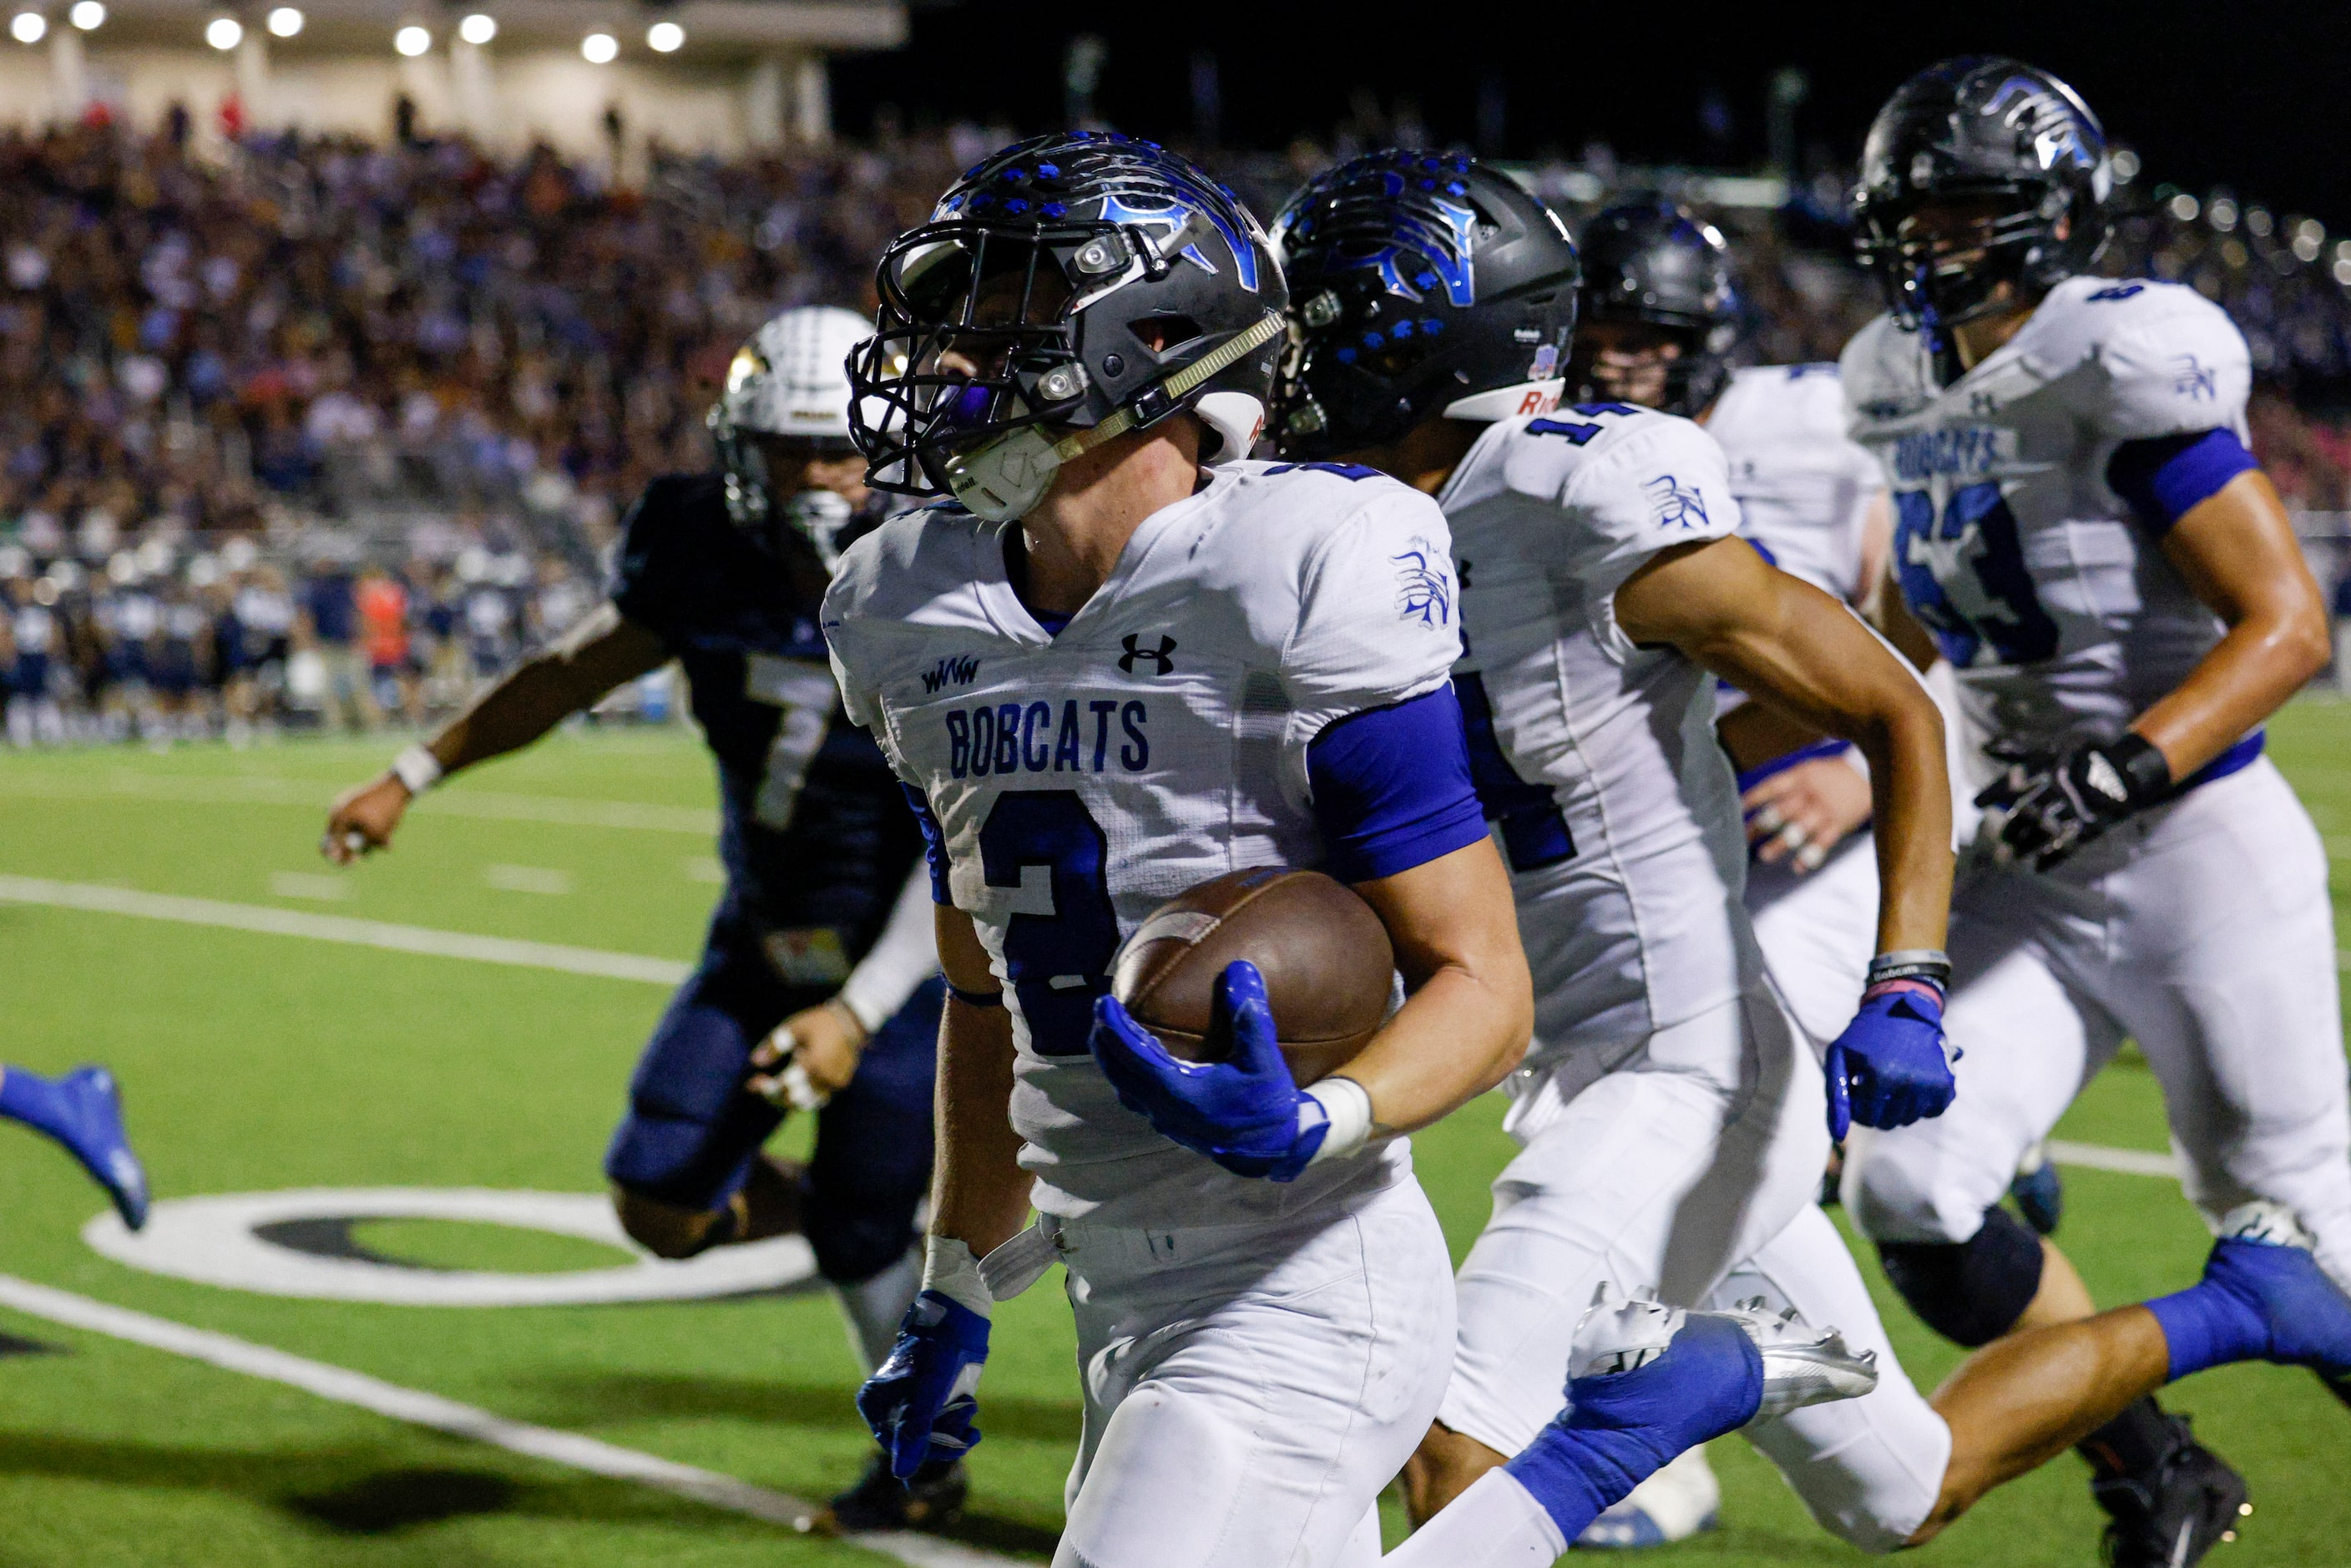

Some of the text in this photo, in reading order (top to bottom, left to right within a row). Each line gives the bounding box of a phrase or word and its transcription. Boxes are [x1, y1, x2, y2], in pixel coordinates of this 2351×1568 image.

[748, 651, 837, 830] 7
[945, 699, 1150, 779] BOBCATS
[978, 789, 1121, 1057] 2
